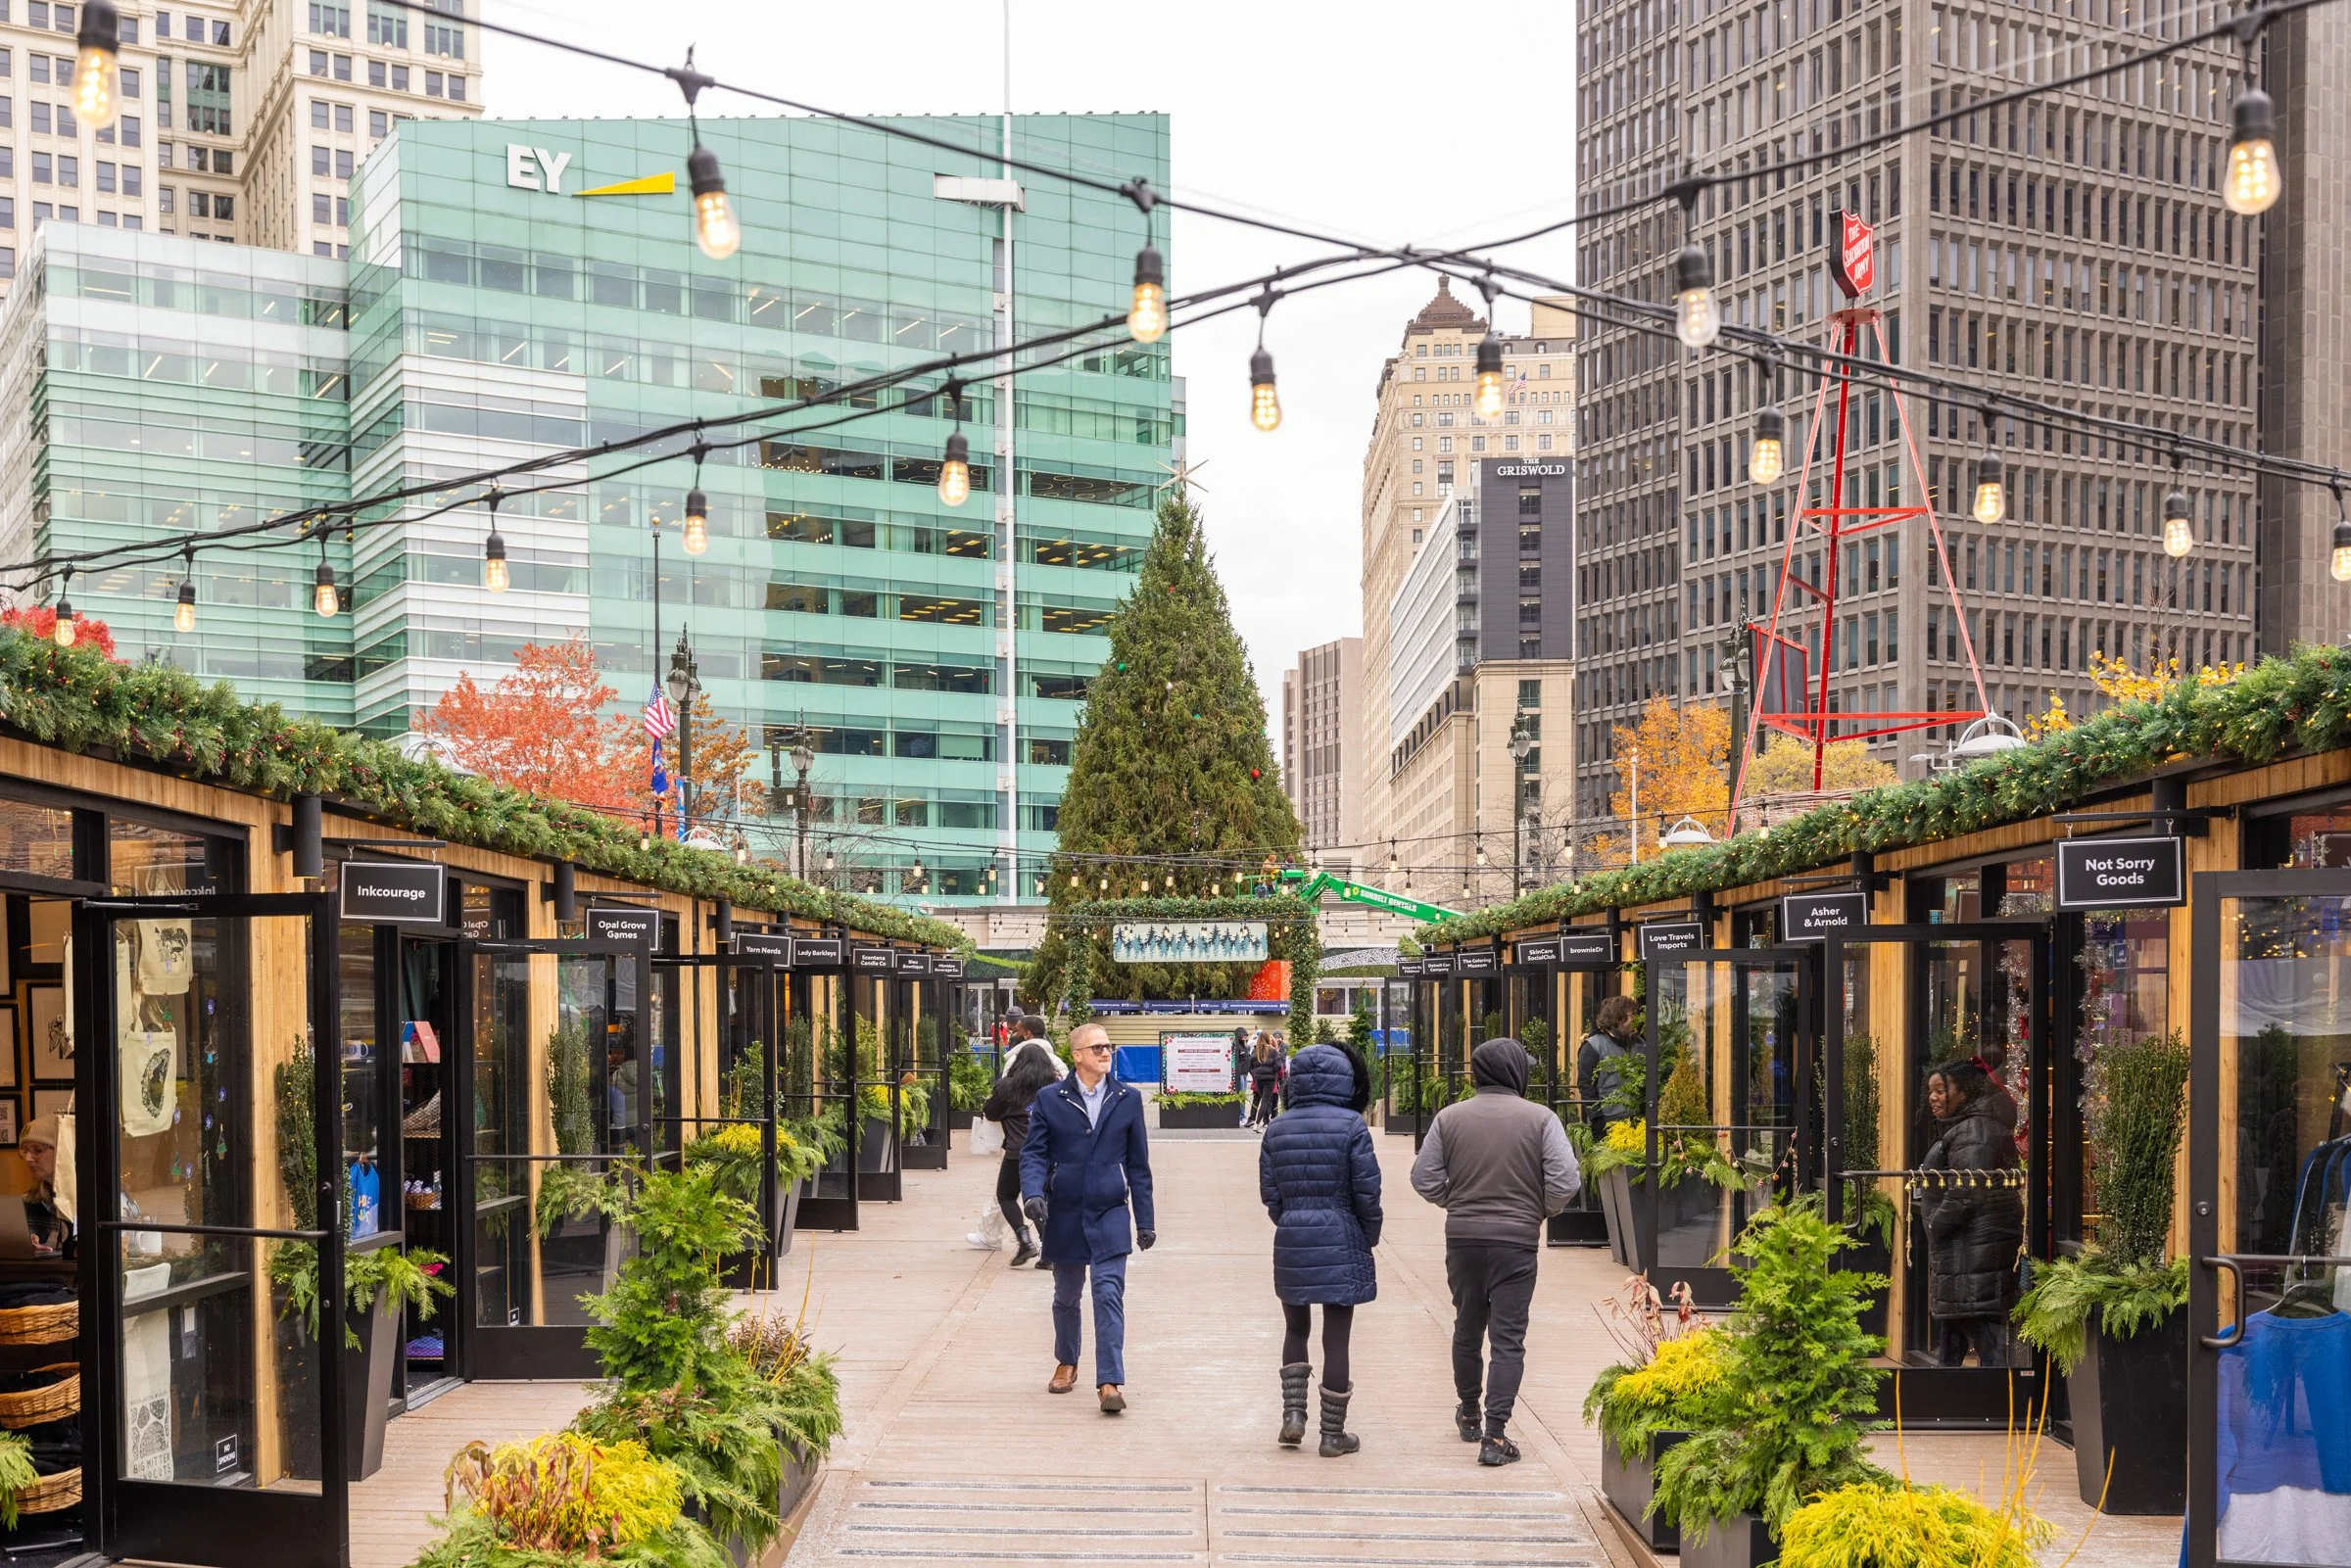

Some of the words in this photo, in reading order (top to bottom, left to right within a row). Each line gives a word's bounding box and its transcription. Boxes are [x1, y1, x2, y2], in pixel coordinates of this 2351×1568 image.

[507, 143, 572, 194] EY
[1848, 222, 1860, 244] THE
[1846, 232, 1870, 267] SALVATION
[1854, 253, 1870, 282] ARMY
[1497, 465, 1565, 476] GRISWOLD
[2086, 859, 2113, 871] Not
[2116, 858, 2155, 871] Sorry
[2096, 873, 2144, 885] Goods
[358, 885, 426, 900] Inkcourage
[1361, 890, 1388, 904] SUNBELT
[1389, 898, 1416, 912] RENTALS
[1811, 907, 1840, 917] Asher
[598, 921, 619, 930] Opal
[1814, 917, 1847, 927] Arnold
[607, 930, 638, 939] Games
[1657, 941, 1688, 950] Imports
[223, 1444, 230, 1452] NO
[218, 1450, 235, 1465] SMOKING
